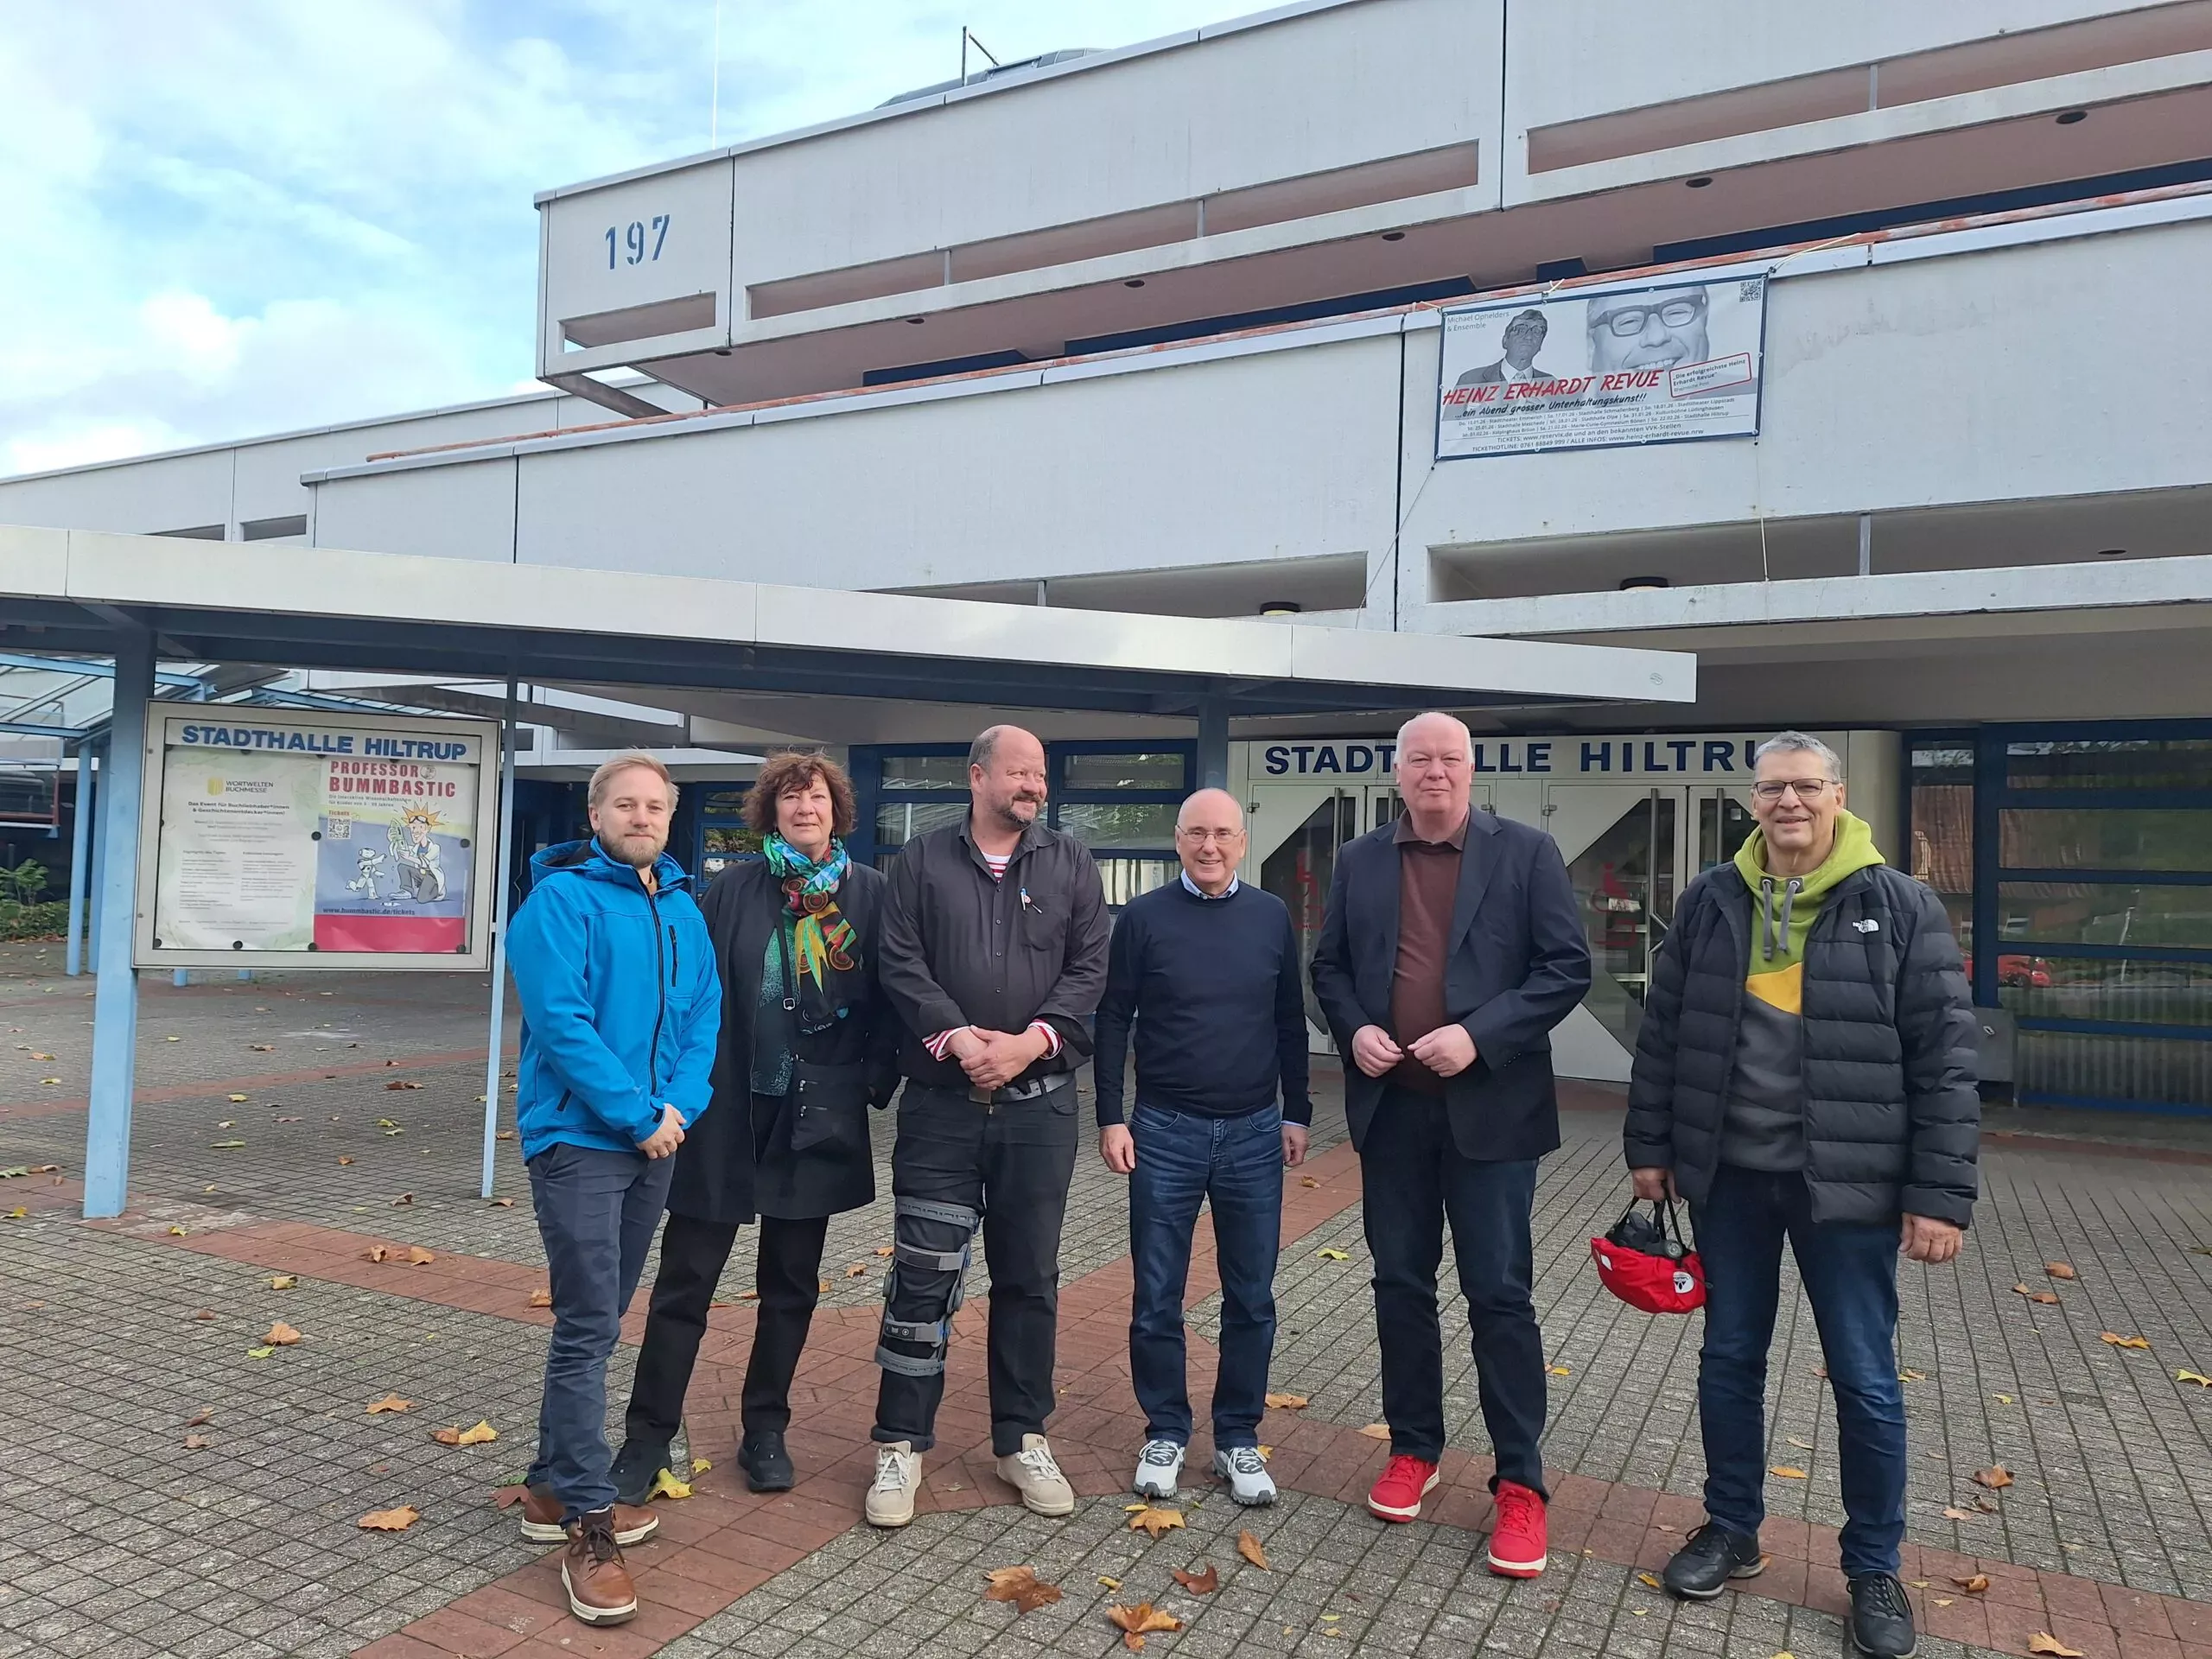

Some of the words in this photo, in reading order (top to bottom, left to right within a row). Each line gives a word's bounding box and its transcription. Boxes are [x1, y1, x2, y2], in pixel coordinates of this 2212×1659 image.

[606, 214, 670, 270] 197
[1447, 315, 1472, 323] Michael
[1453, 322, 1486, 331] Ensemble
[1442, 385, 1500, 405] HEINZ
[1503, 376, 1597, 400] ERHARDT
[1599, 369, 1664, 391] REVUE
[1479, 404, 1509, 415] Abend
[1511, 403, 1545, 415] grosser
[1548, 393, 1647, 410] Unterhaltungskunst!!
[1609, 428, 1704, 441] www.heinz-erhardt-revue.nrw
[1610, 425, 1643, 434] bekannten
[182, 724, 353, 753] STADTHALLE
[365, 737, 467, 760] HILTRUP
[330, 760, 418, 778] PROFESSOR
[1265, 743, 1552, 775] STADTLLE
[329, 776, 455, 798] BUMMBASTIC
